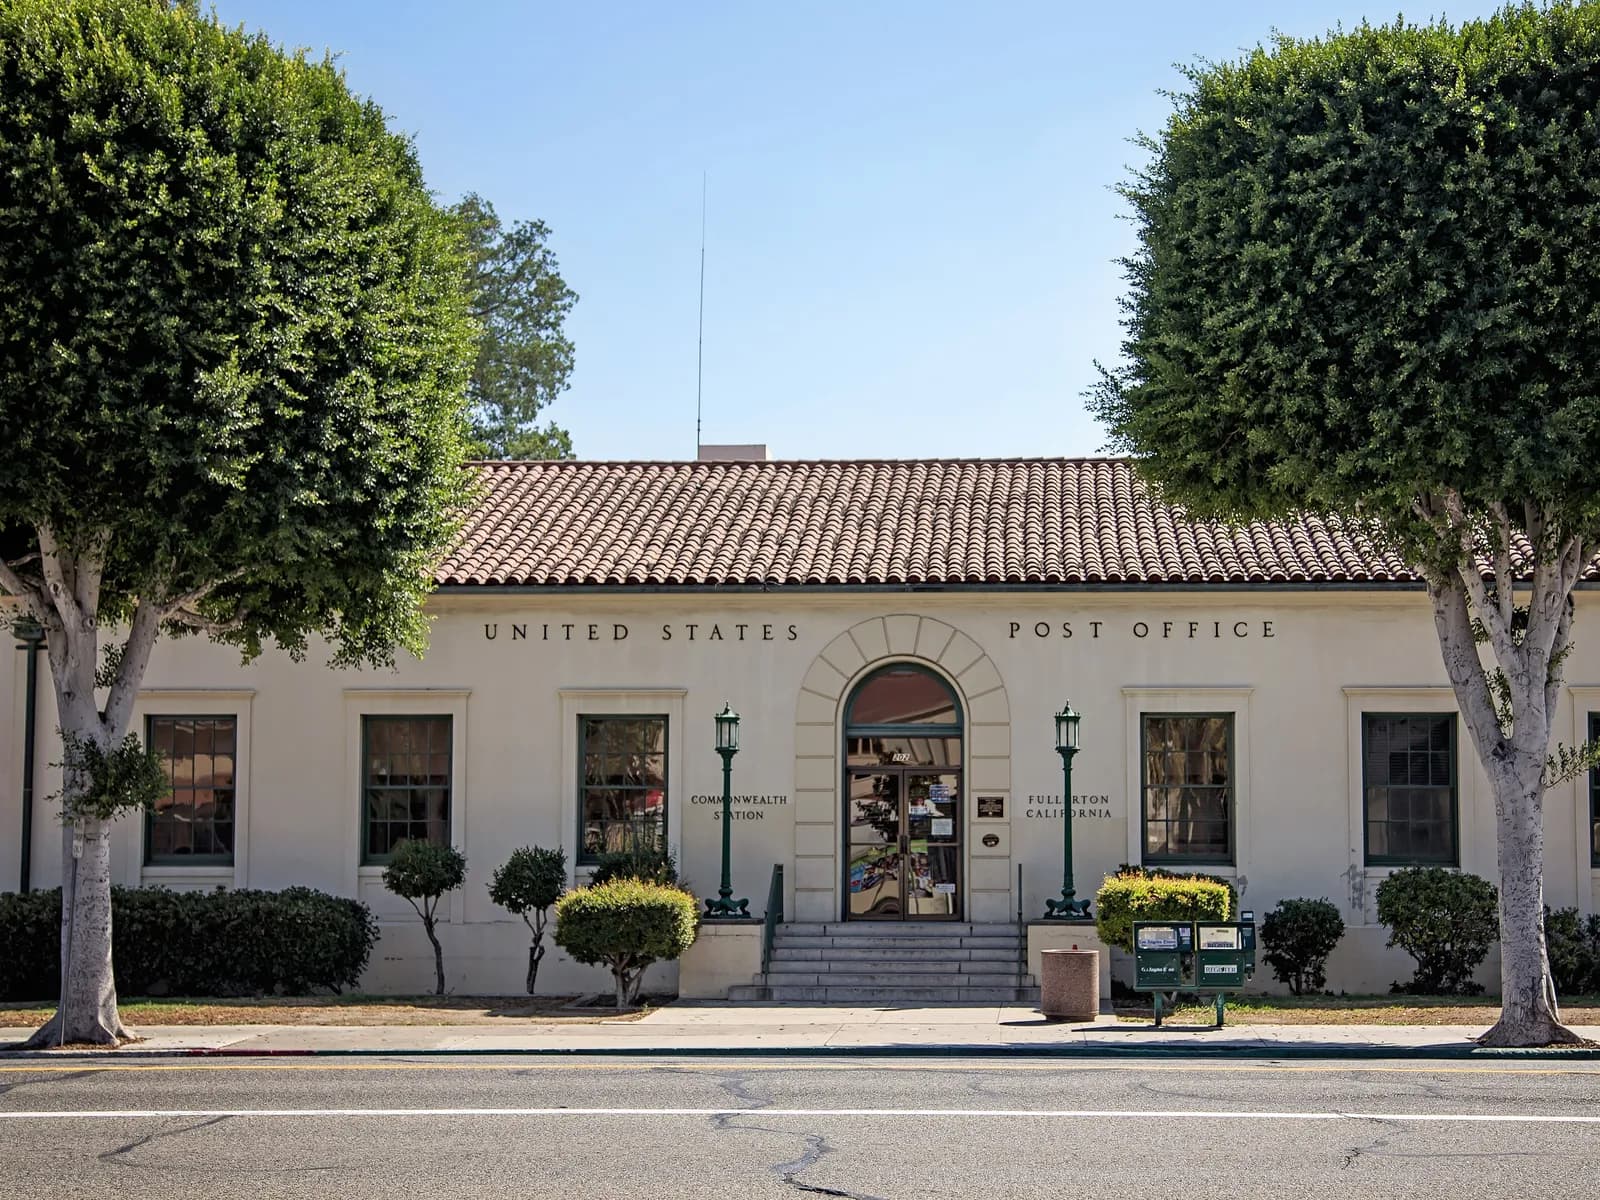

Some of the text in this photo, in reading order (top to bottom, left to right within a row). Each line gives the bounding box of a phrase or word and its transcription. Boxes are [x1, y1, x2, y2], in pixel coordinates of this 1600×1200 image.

[484, 623, 798, 641] UNITED STATES
[1008, 621, 1276, 639] POST OFFICE
[690, 794, 787, 805] COMMNWEALTH
[1028, 794, 1109, 804] FULLRTON
